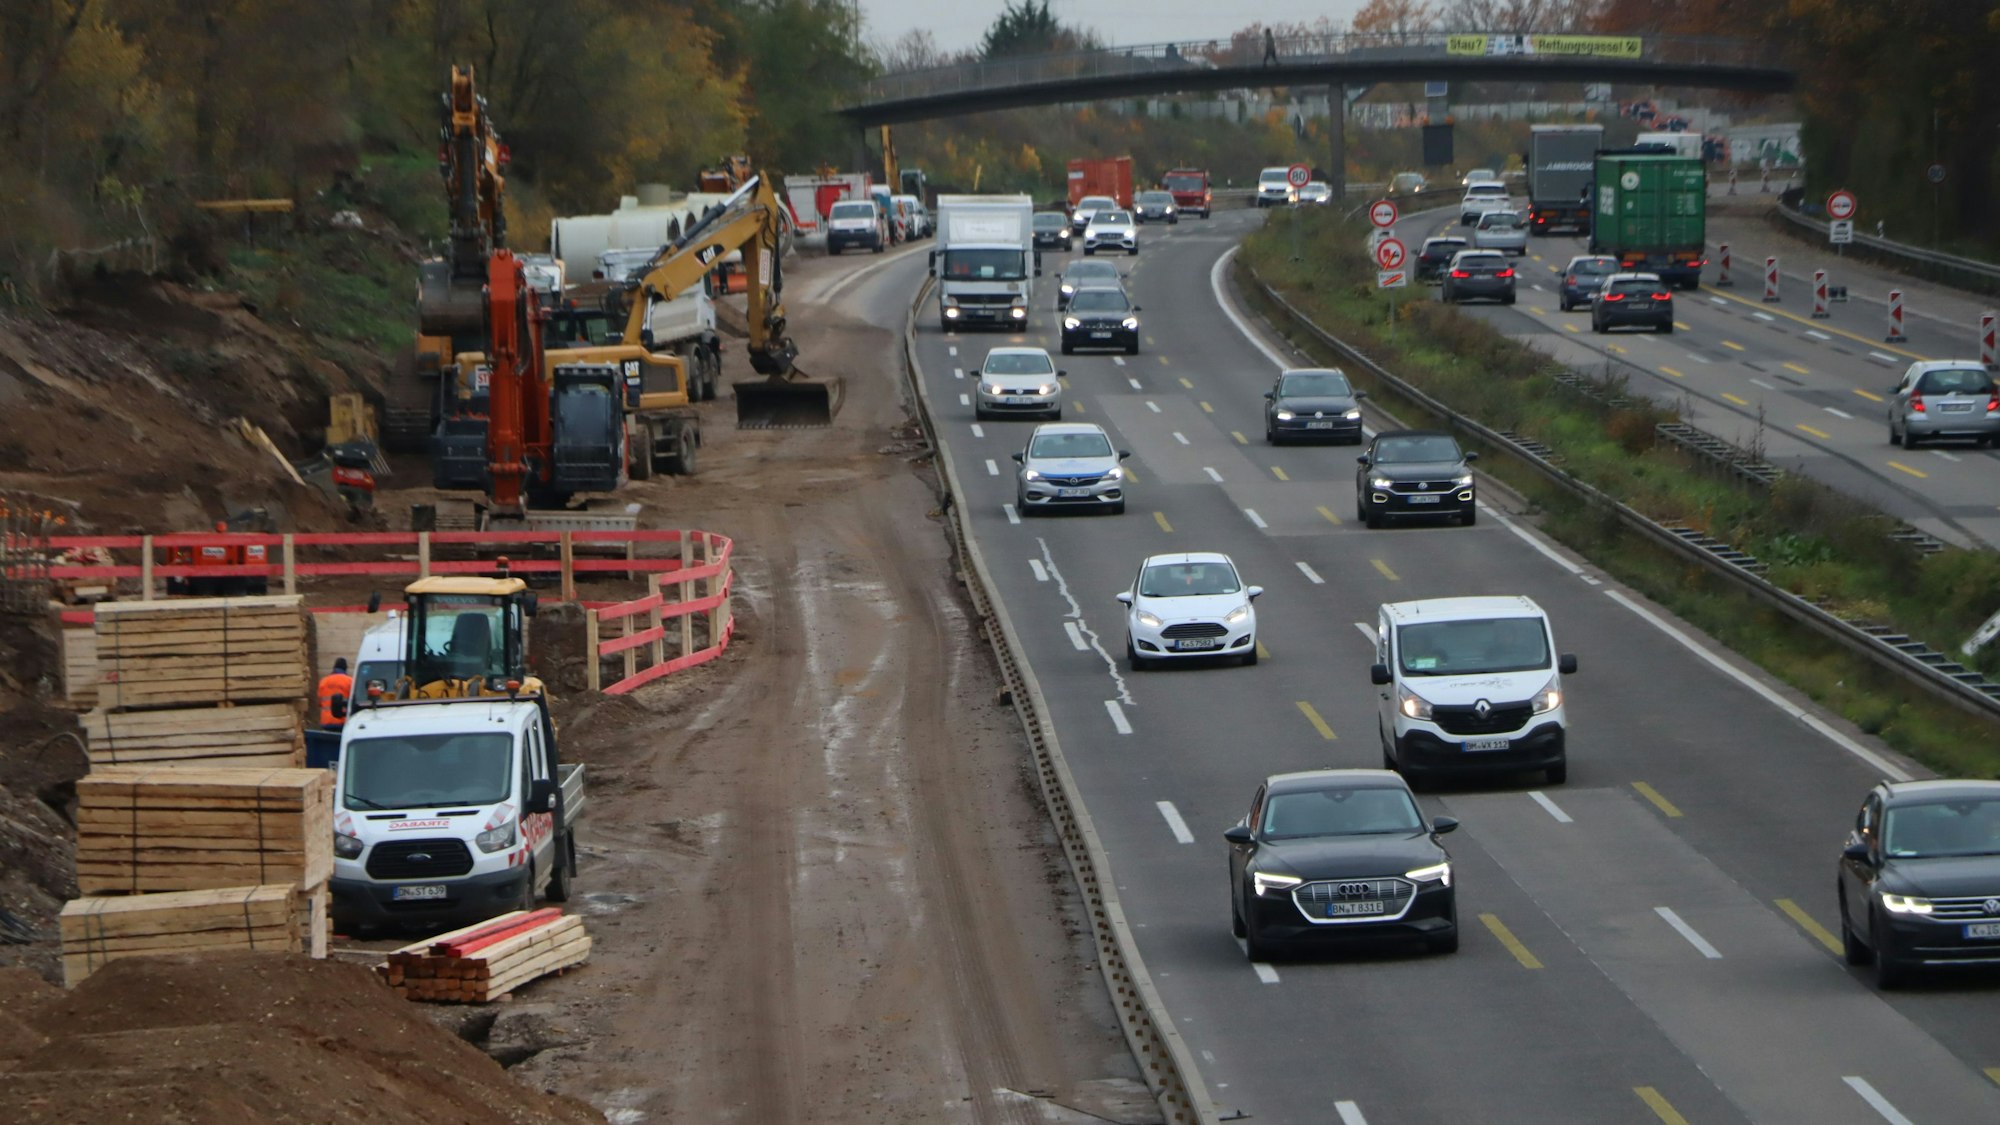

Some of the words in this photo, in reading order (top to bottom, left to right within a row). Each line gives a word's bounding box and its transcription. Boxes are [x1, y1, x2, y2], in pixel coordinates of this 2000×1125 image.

[1449, 38, 1482, 51] Stau?
[1538, 38, 1623, 55] Rettungsgasse!
[1291, 170, 1305, 182] 80
[702, 246, 716, 264] CAT
[624, 361, 640, 377] CAT
[435, 594, 478, 604] VOLVO
